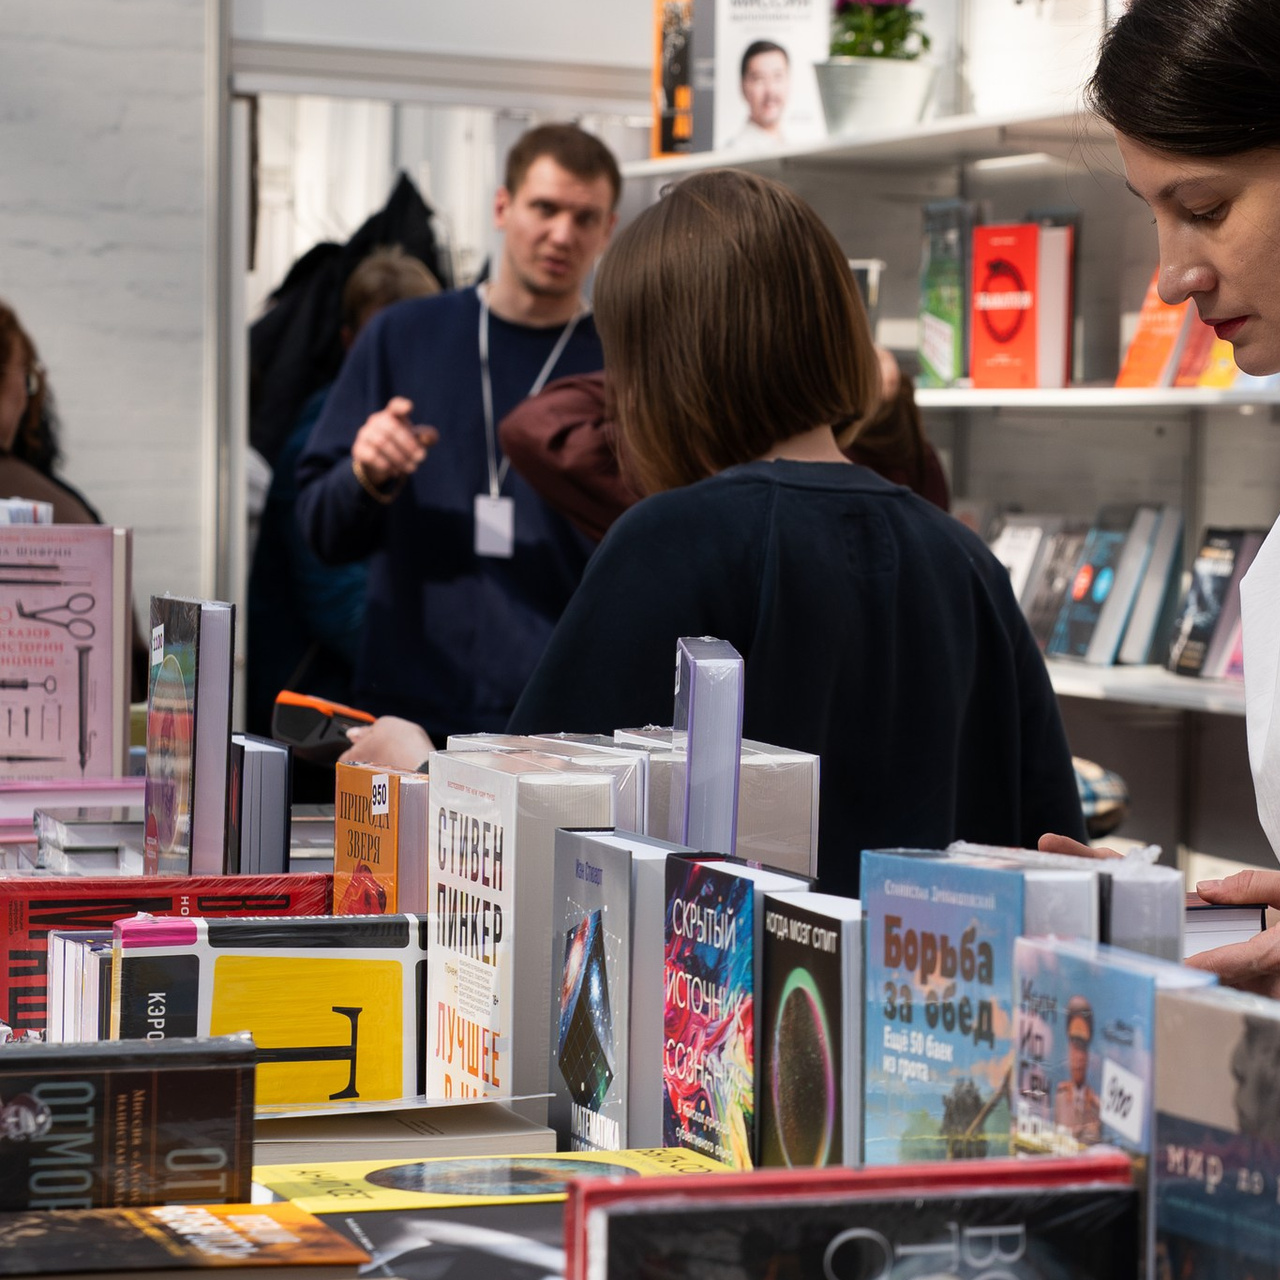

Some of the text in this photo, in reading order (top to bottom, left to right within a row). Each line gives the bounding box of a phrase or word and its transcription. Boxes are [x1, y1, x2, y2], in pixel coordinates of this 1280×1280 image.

[0, 628, 51, 640] КАЗОВ
[371, 782, 387, 807] 950
[347, 829, 381, 865] ЗВЕРЯ
[438, 807, 504, 892] СТИВЕН
[436, 882, 503, 967] ПИНКЕР
[672, 898, 737, 954] СКРЫТЫЙ
[766, 910, 838, 954] КОГДА МОЗГ СПИТ
[884, 914, 994, 986] Борьба
[666, 966, 745, 1031] ИСТОЧНИК
[883, 981, 913, 1024] за
[925, 982, 994, 1050] обед
[436, 1001, 501, 1089] ЛУЧШЕЕ
[883, 1025, 953, 1062] Ещё 50 баек
[665, 1038, 744, 1105] СОЗНАНИЯ
[883, 1054, 930, 1084] из грота
[570, 1102, 621, 1152] МАТЕМАТИКА
[675, 1125, 715, 1154] субъективного
[682, 1101, 706, 1126] поисках
[705, 1114, 731, 1138] природы
[165, 1147, 228, 1205] ОТ
[1166, 1144, 1224, 1194] мир
